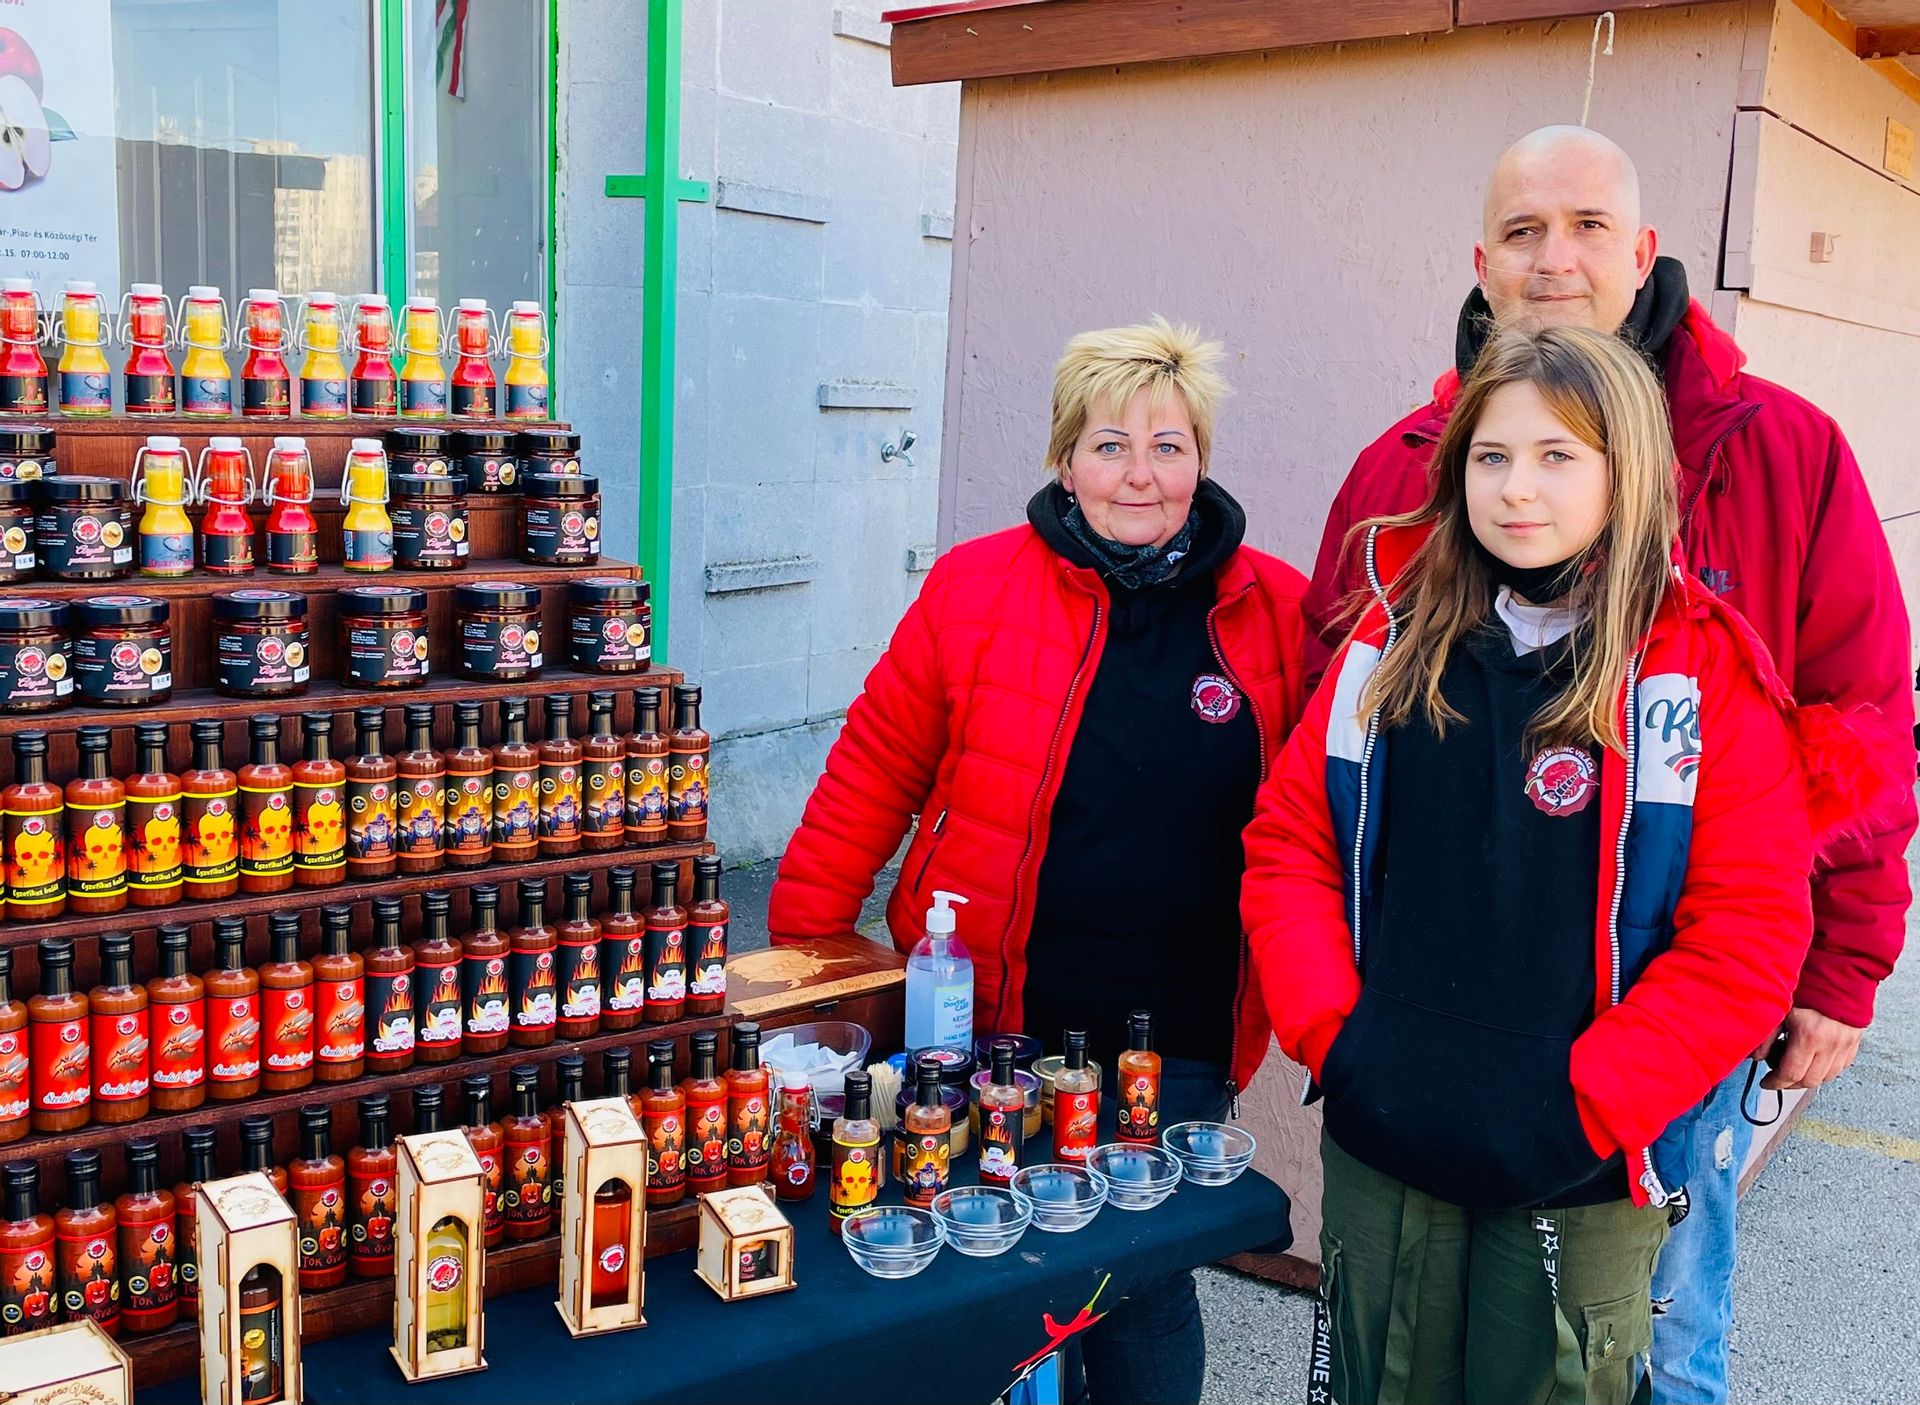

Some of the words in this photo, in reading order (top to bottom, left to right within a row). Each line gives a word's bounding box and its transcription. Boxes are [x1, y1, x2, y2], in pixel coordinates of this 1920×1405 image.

[44, 231, 83, 242] Közösségi
[1532, 754, 1546, 772] BOGI
[1575, 749, 1594, 774] VILÁGA
[943, 998, 967, 1008] Doctor
[1313, 1319, 1330, 1384] SHINE
